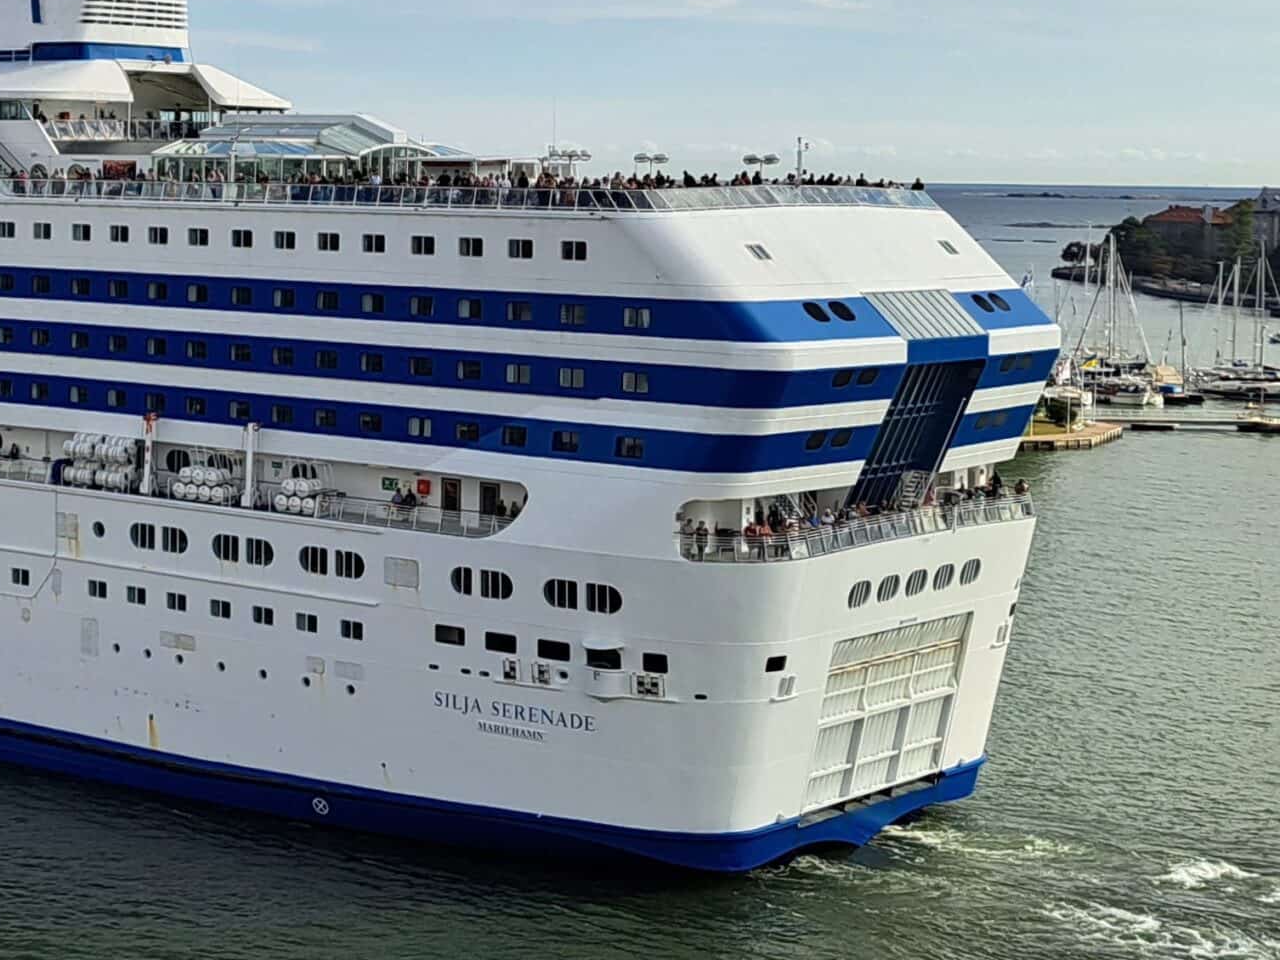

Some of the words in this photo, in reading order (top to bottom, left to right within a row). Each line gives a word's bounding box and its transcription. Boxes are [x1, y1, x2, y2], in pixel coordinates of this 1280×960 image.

[434, 692, 482, 715] SILJA
[491, 701, 595, 731] SERENADE
[477, 721, 544, 740] MARIEHAMN
